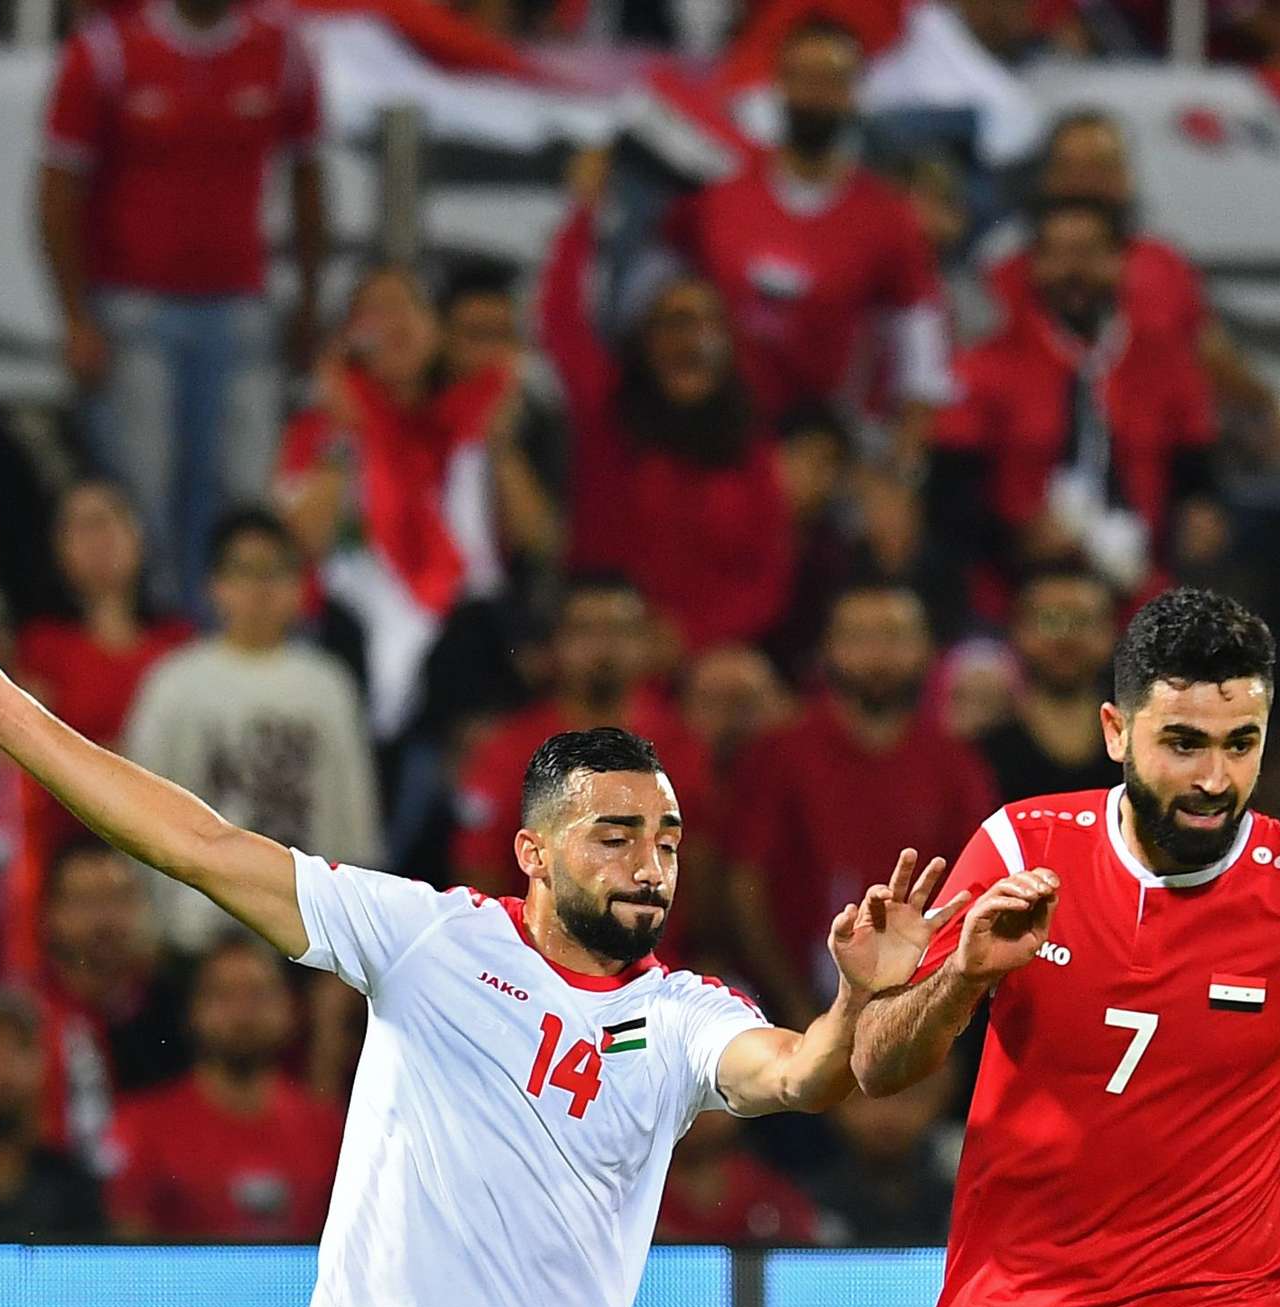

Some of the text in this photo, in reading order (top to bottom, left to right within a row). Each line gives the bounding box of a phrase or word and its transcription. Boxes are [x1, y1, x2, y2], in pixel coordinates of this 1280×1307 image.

[1034, 940, 1072, 967] KO
[476, 971, 530, 1003] JAKO
[525, 1011, 603, 1120] 14
[1104, 1007, 1160, 1095] 7
